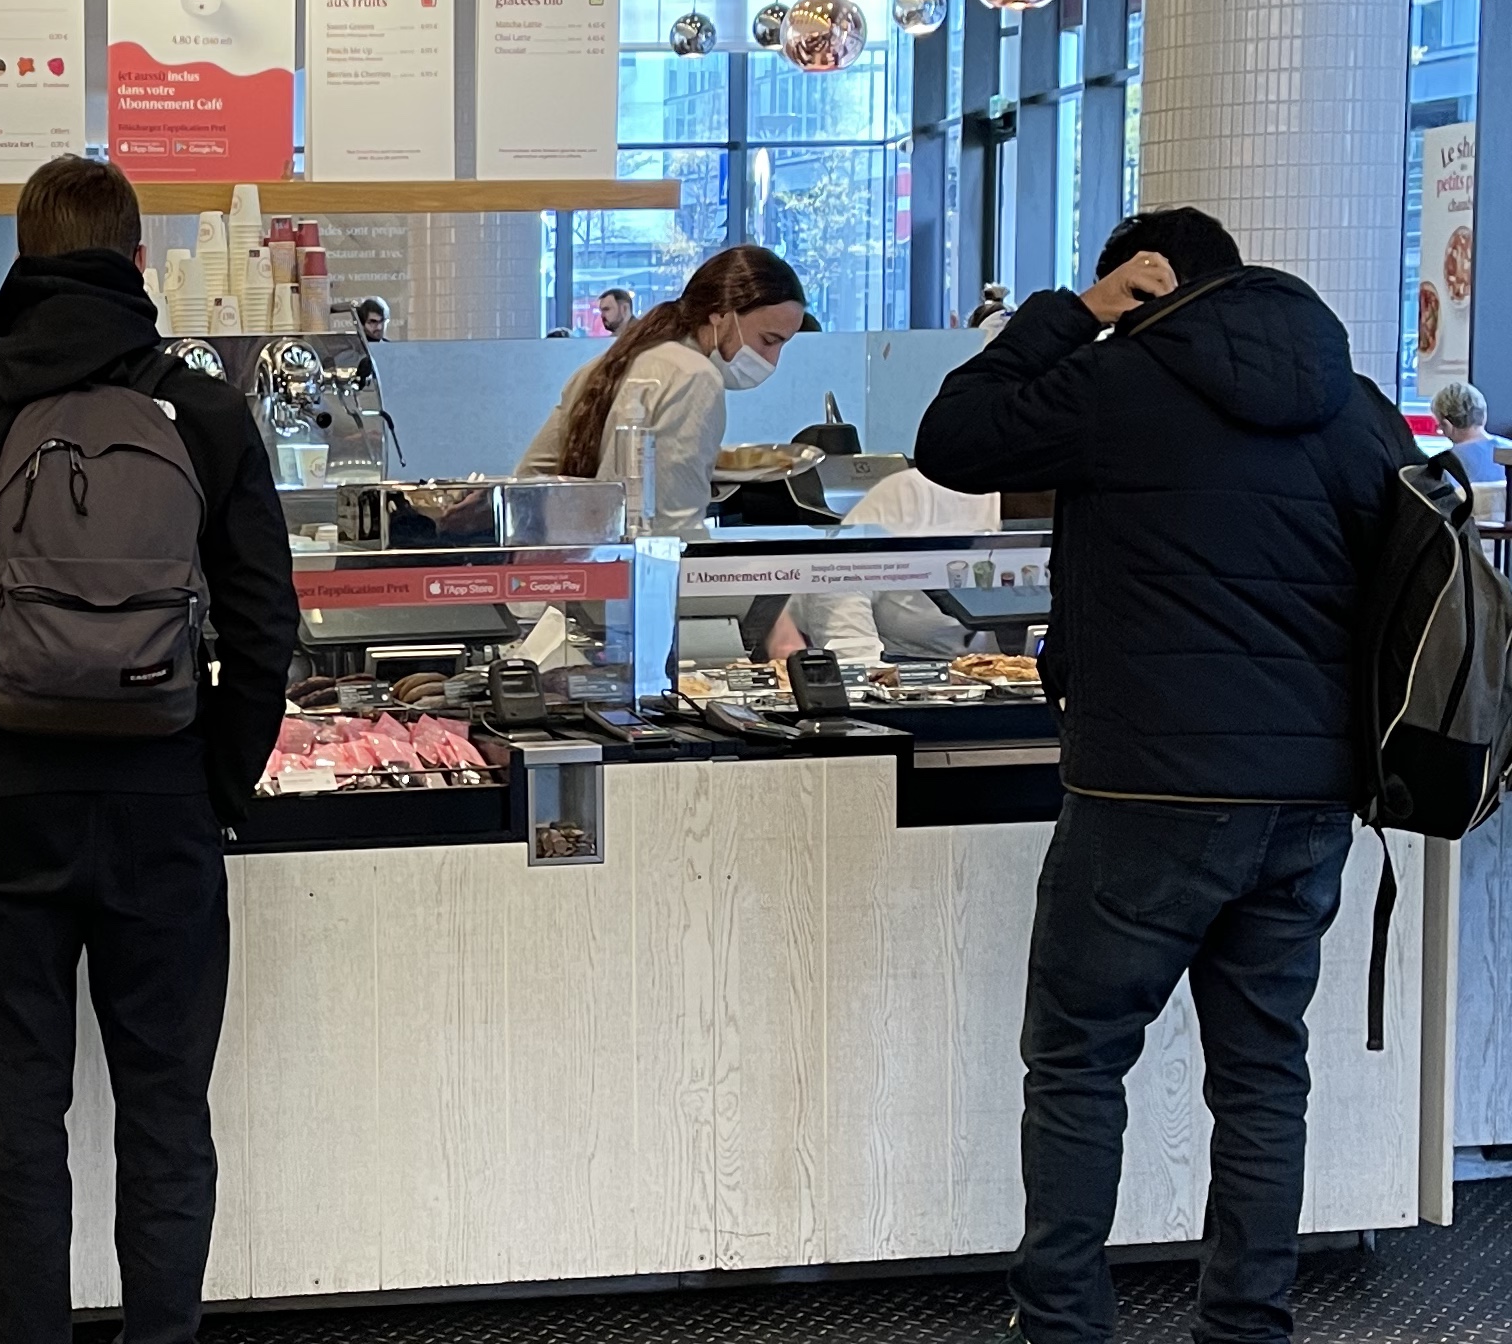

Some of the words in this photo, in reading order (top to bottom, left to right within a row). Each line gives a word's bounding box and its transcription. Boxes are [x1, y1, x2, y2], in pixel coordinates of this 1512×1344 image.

[118, 71, 132, 81] (et
[134, 71, 166, 81] aussi)
[168, 71, 200, 82] inclus
[117, 85, 144, 95] dans
[146, 86, 175, 96] votre
[118, 98, 194, 110] Abonnement
[197, 98, 223, 111] Café
[189, 146, 211, 154] Google
[211, 146, 224, 154] Play
[1441, 146, 1454, 168] Le
[1437, 171, 1464, 198] petits
[687, 570, 772, 584] L'Abonnement
[774, 568, 800, 581] Café
[387, 584, 409, 593] Pret
[444, 585, 467, 595] l'App
[469, 584, 493, 593] Store
[530, 581, 561, 593] Google
[563, 581, 581, 591] Play
